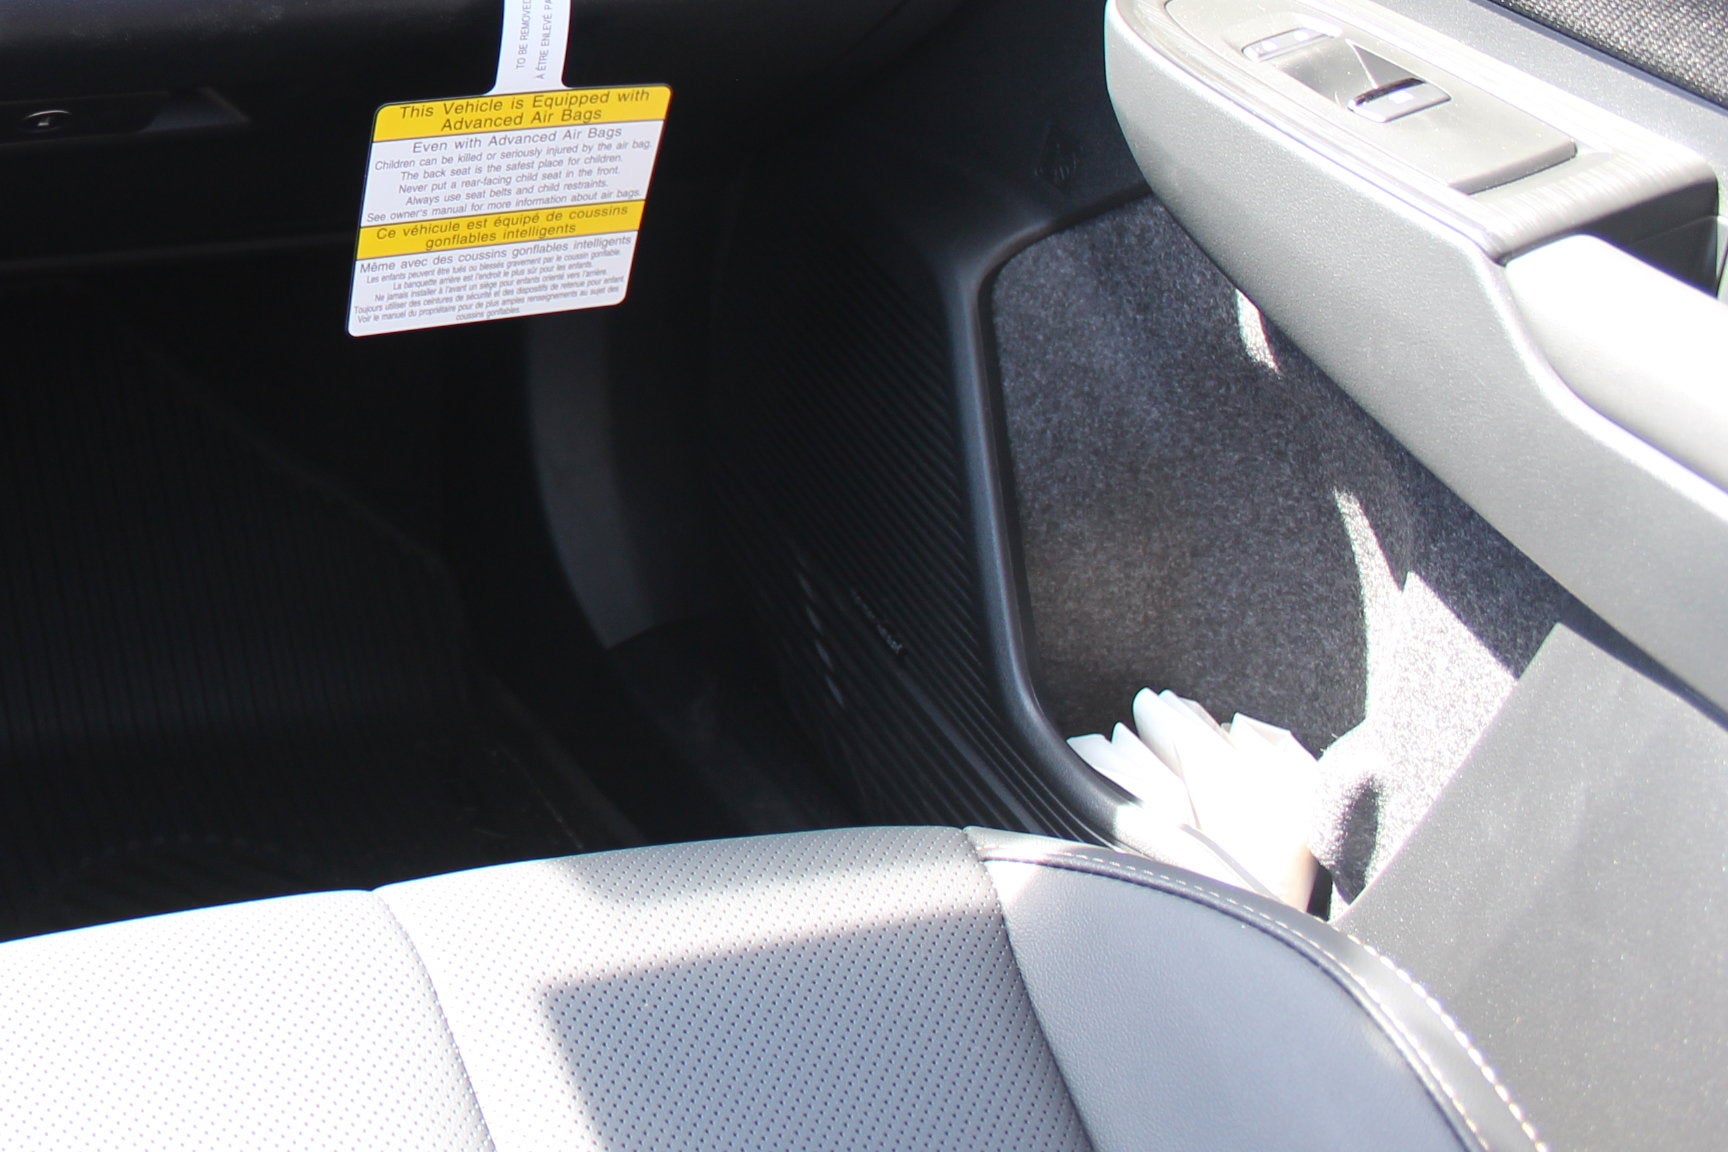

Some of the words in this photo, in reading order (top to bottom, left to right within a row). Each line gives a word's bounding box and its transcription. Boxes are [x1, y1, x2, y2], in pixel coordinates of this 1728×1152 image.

[518, 43, 528, 55] BE
[516, 57, 526, 70] TO
[399, 105, 434, 119] This
[443, 98, 503, 116] Vehicle
[511, 97, 524, 109] is
[532, 91, 610, 109] Equipped
[617, 89, 650, 103] with
[441, 113, 523, 131] Advanced
[531, 111, 553, 124] Air
[561, 108, 602, 124] Bags
[412, 141, 448, 154] Even
[454, 136, 482, 149] with
[488, 131, 557, 147] Advanced
[562, 129, 582, 141] Air
[587, 127, 623, 141] Bags
[375, 159, 416, 171] Children
[419, 158, 438, 167] can
[441, 155, 454, 164] be
[457, 152, 483, 163] killed
[500, 147, 543, 160] seriously
[545, 144, 578, 156] injured
[582, 143, 594, 153] by
[597, 141, 612, 150] the
[616, 140, 629, 149] air
[400, 171, 419, 181] The
[423, 168, 446, 179] back
[450, 167, 471, 177] seat
[474, 165, 483, 174] is
[487, 163, 502, 173] the
[506, 159, 535, 172] safest
[537, 158, 564, 170] place
[567, 156, 581, 166] for
[398, 184, 428, 194] Never
[431, 182, 448, 193] put
[451, 180, 457, 189] a
[461, 175, 512, 188] rear-facing
[515, 172, 538, 183] child
[541, 170, 562, 180] seat
[565, 168, 575, 178] in
[578, 167, 593, 177] the
[366, 213, 386, 223] See
[390, 209, 428, 220] owner's
[431, 204, 467, 216] manual
[471, 202, 484, 211] for
[487, 200, 511, 210] more
[515, 195, 567, 207] information
[571, 192, 598, 202] about
[601, 191, 613, 200] air
[405, 195, 440, 206] Always
[444, 193, 462, 202] use
[465, 190, 486, 200] seat
[489, 188, 512, 198] belts
[515, 185, 534, 195] and
[537, 183, 560, 193] child
[376, 228, 396, 240] Ce
[402, 221, 460, 237] véhicule
[467, 219, 488, 230] est
[494, 212, 540, 228] équipé
[546, 211, 563, 222] de
[569, 206, 629, 220] coussins
[425, 232, 497, 251] gonflables
[503, 224, 576, 240] intelligents
[359, 262, 396, 274] Même
[400, 258, 428, 269] avec
[432, 255, 454, 266] des
[458, 249, 507, 262] coussins
[512, 243, 569, 258] gonflables
[573, 235, 632, 249] intelligents
